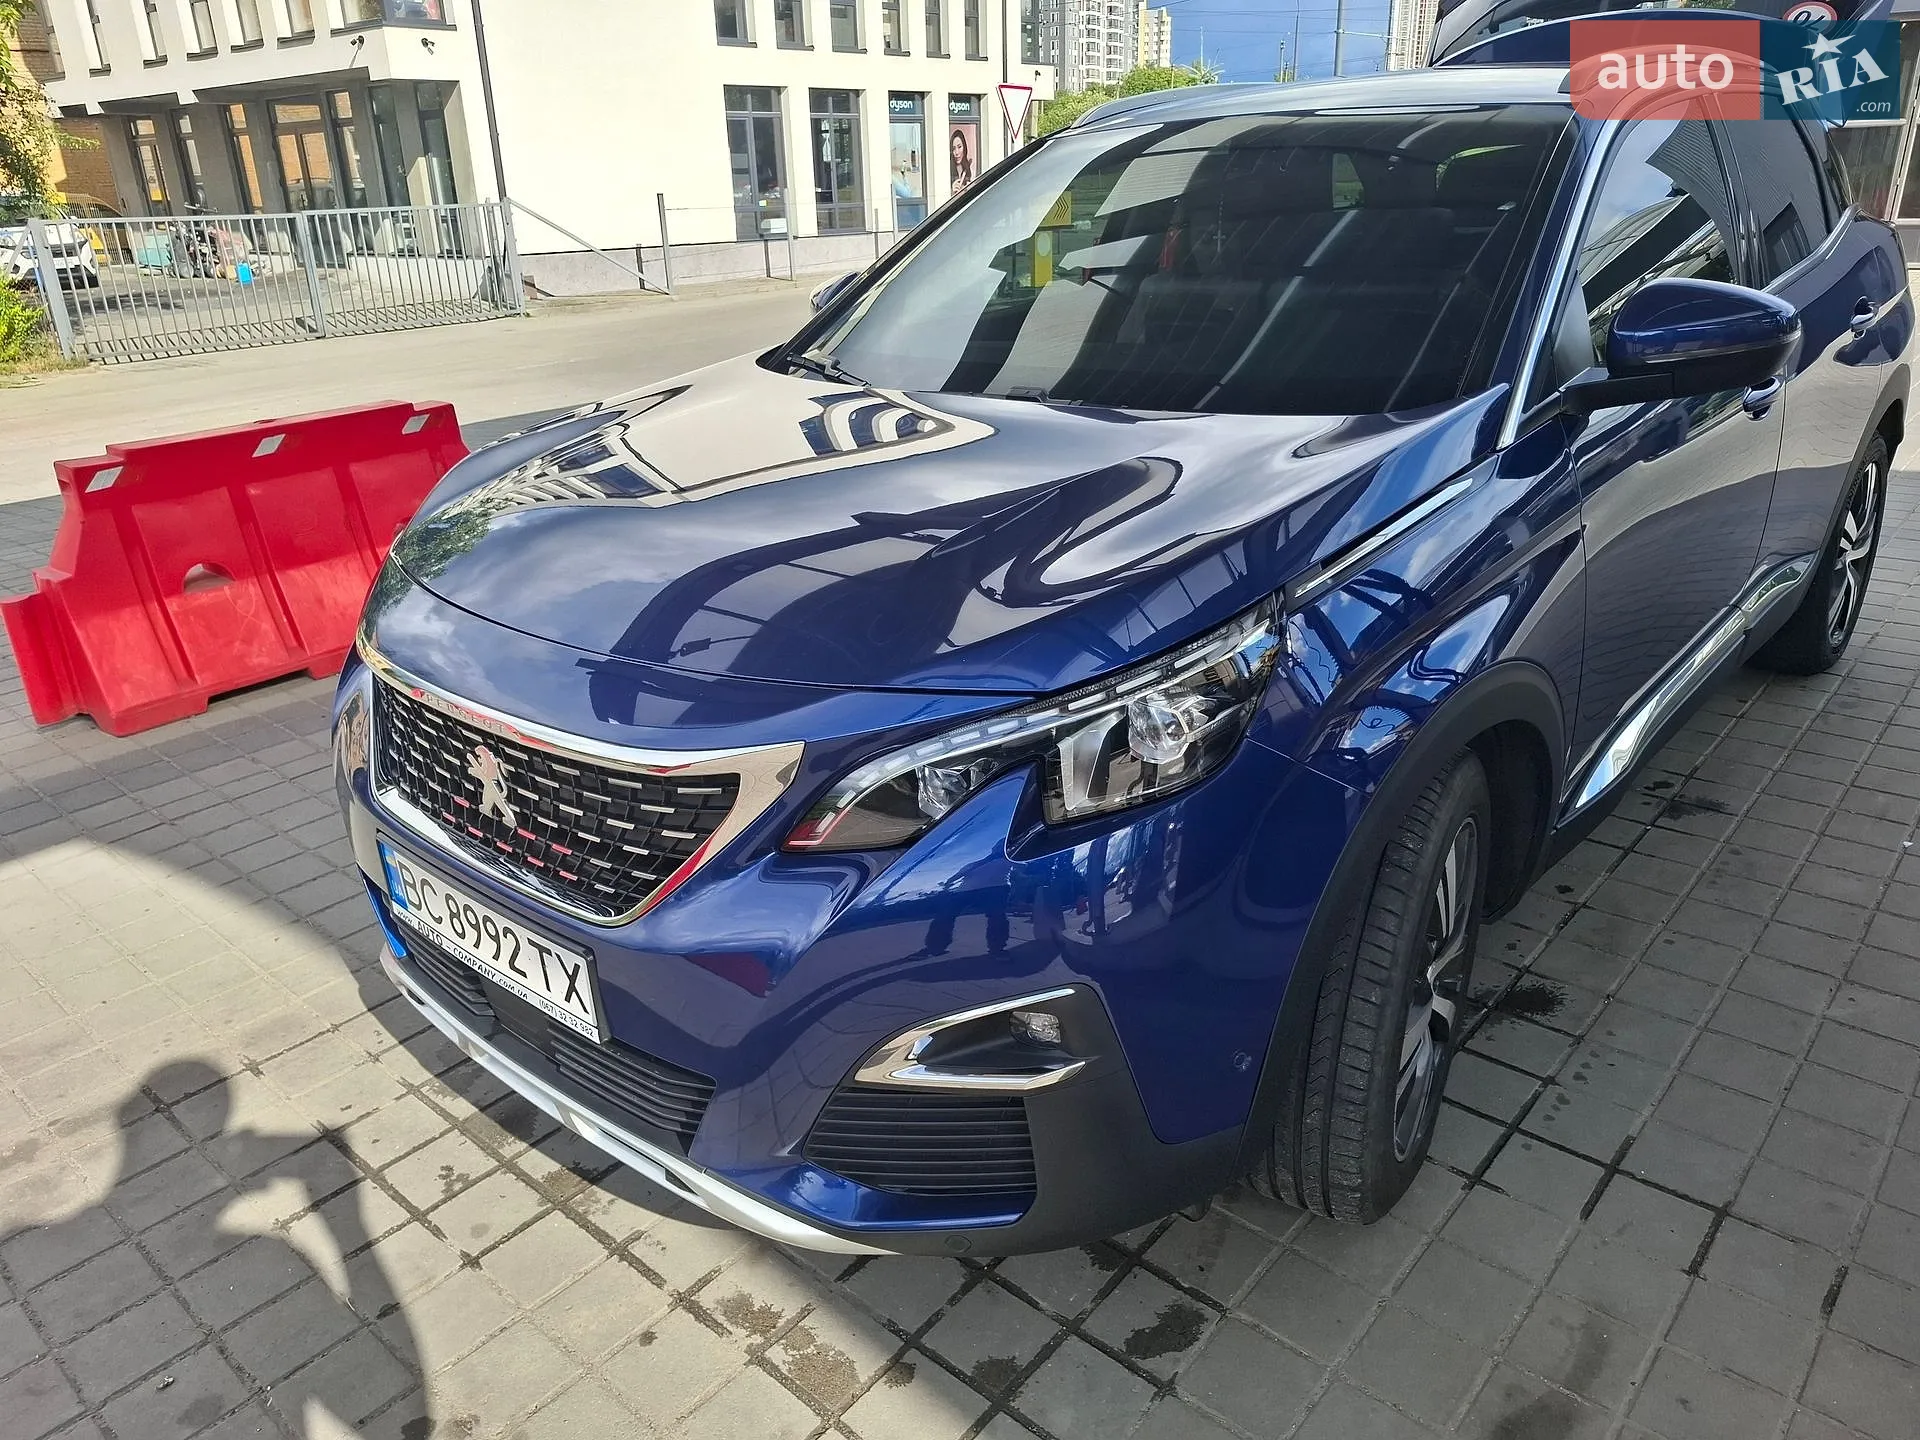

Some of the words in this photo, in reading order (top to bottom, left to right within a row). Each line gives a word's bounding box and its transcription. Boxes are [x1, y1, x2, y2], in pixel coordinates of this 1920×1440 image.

[889, 99, 913, 112] dyson
[949, 101, 970, 114] dyson
[397, 859, 444, 925] BC
[445, 893, 528, 979] 8992
[527, 937, 591, 1016] TX
[417, 920, 443, 946] AUTO
